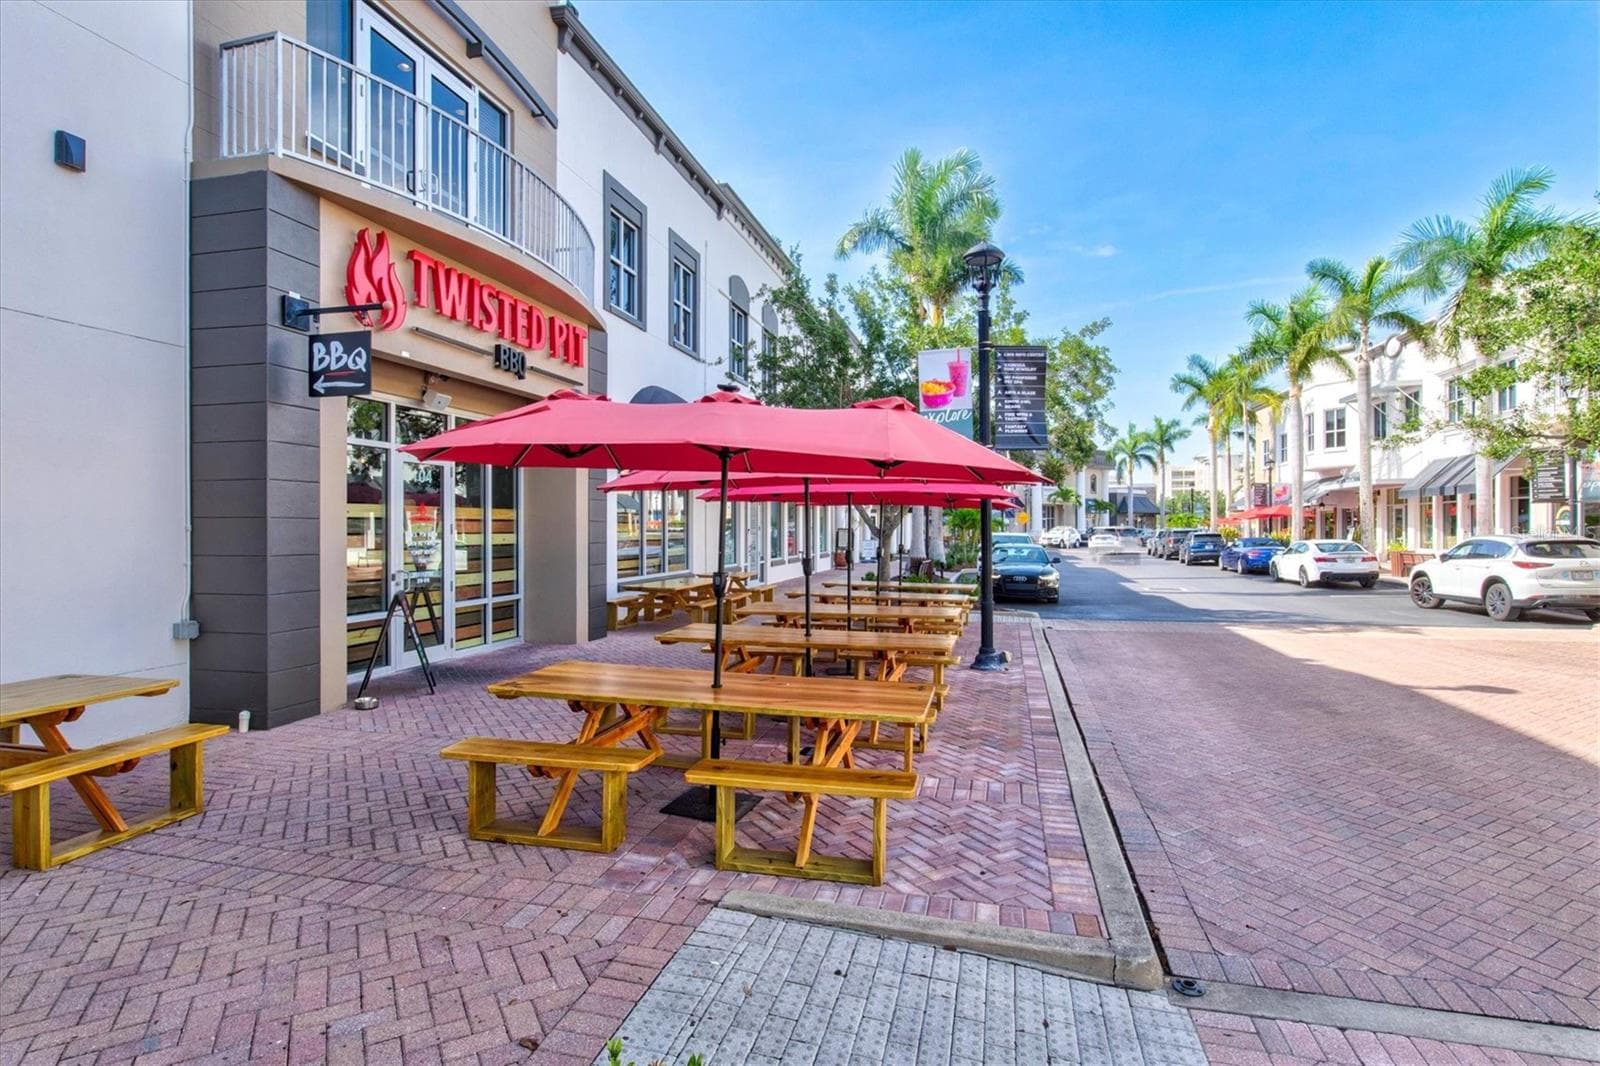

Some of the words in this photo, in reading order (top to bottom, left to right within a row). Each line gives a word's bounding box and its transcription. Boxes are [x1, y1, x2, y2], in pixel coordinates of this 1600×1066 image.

[408, 250, 547, 350] TWISTED
[549, 315, 588, 368] PIT
[312, 341, 368, 372] BBQ
[495, 344, 527, 380] BBQ
